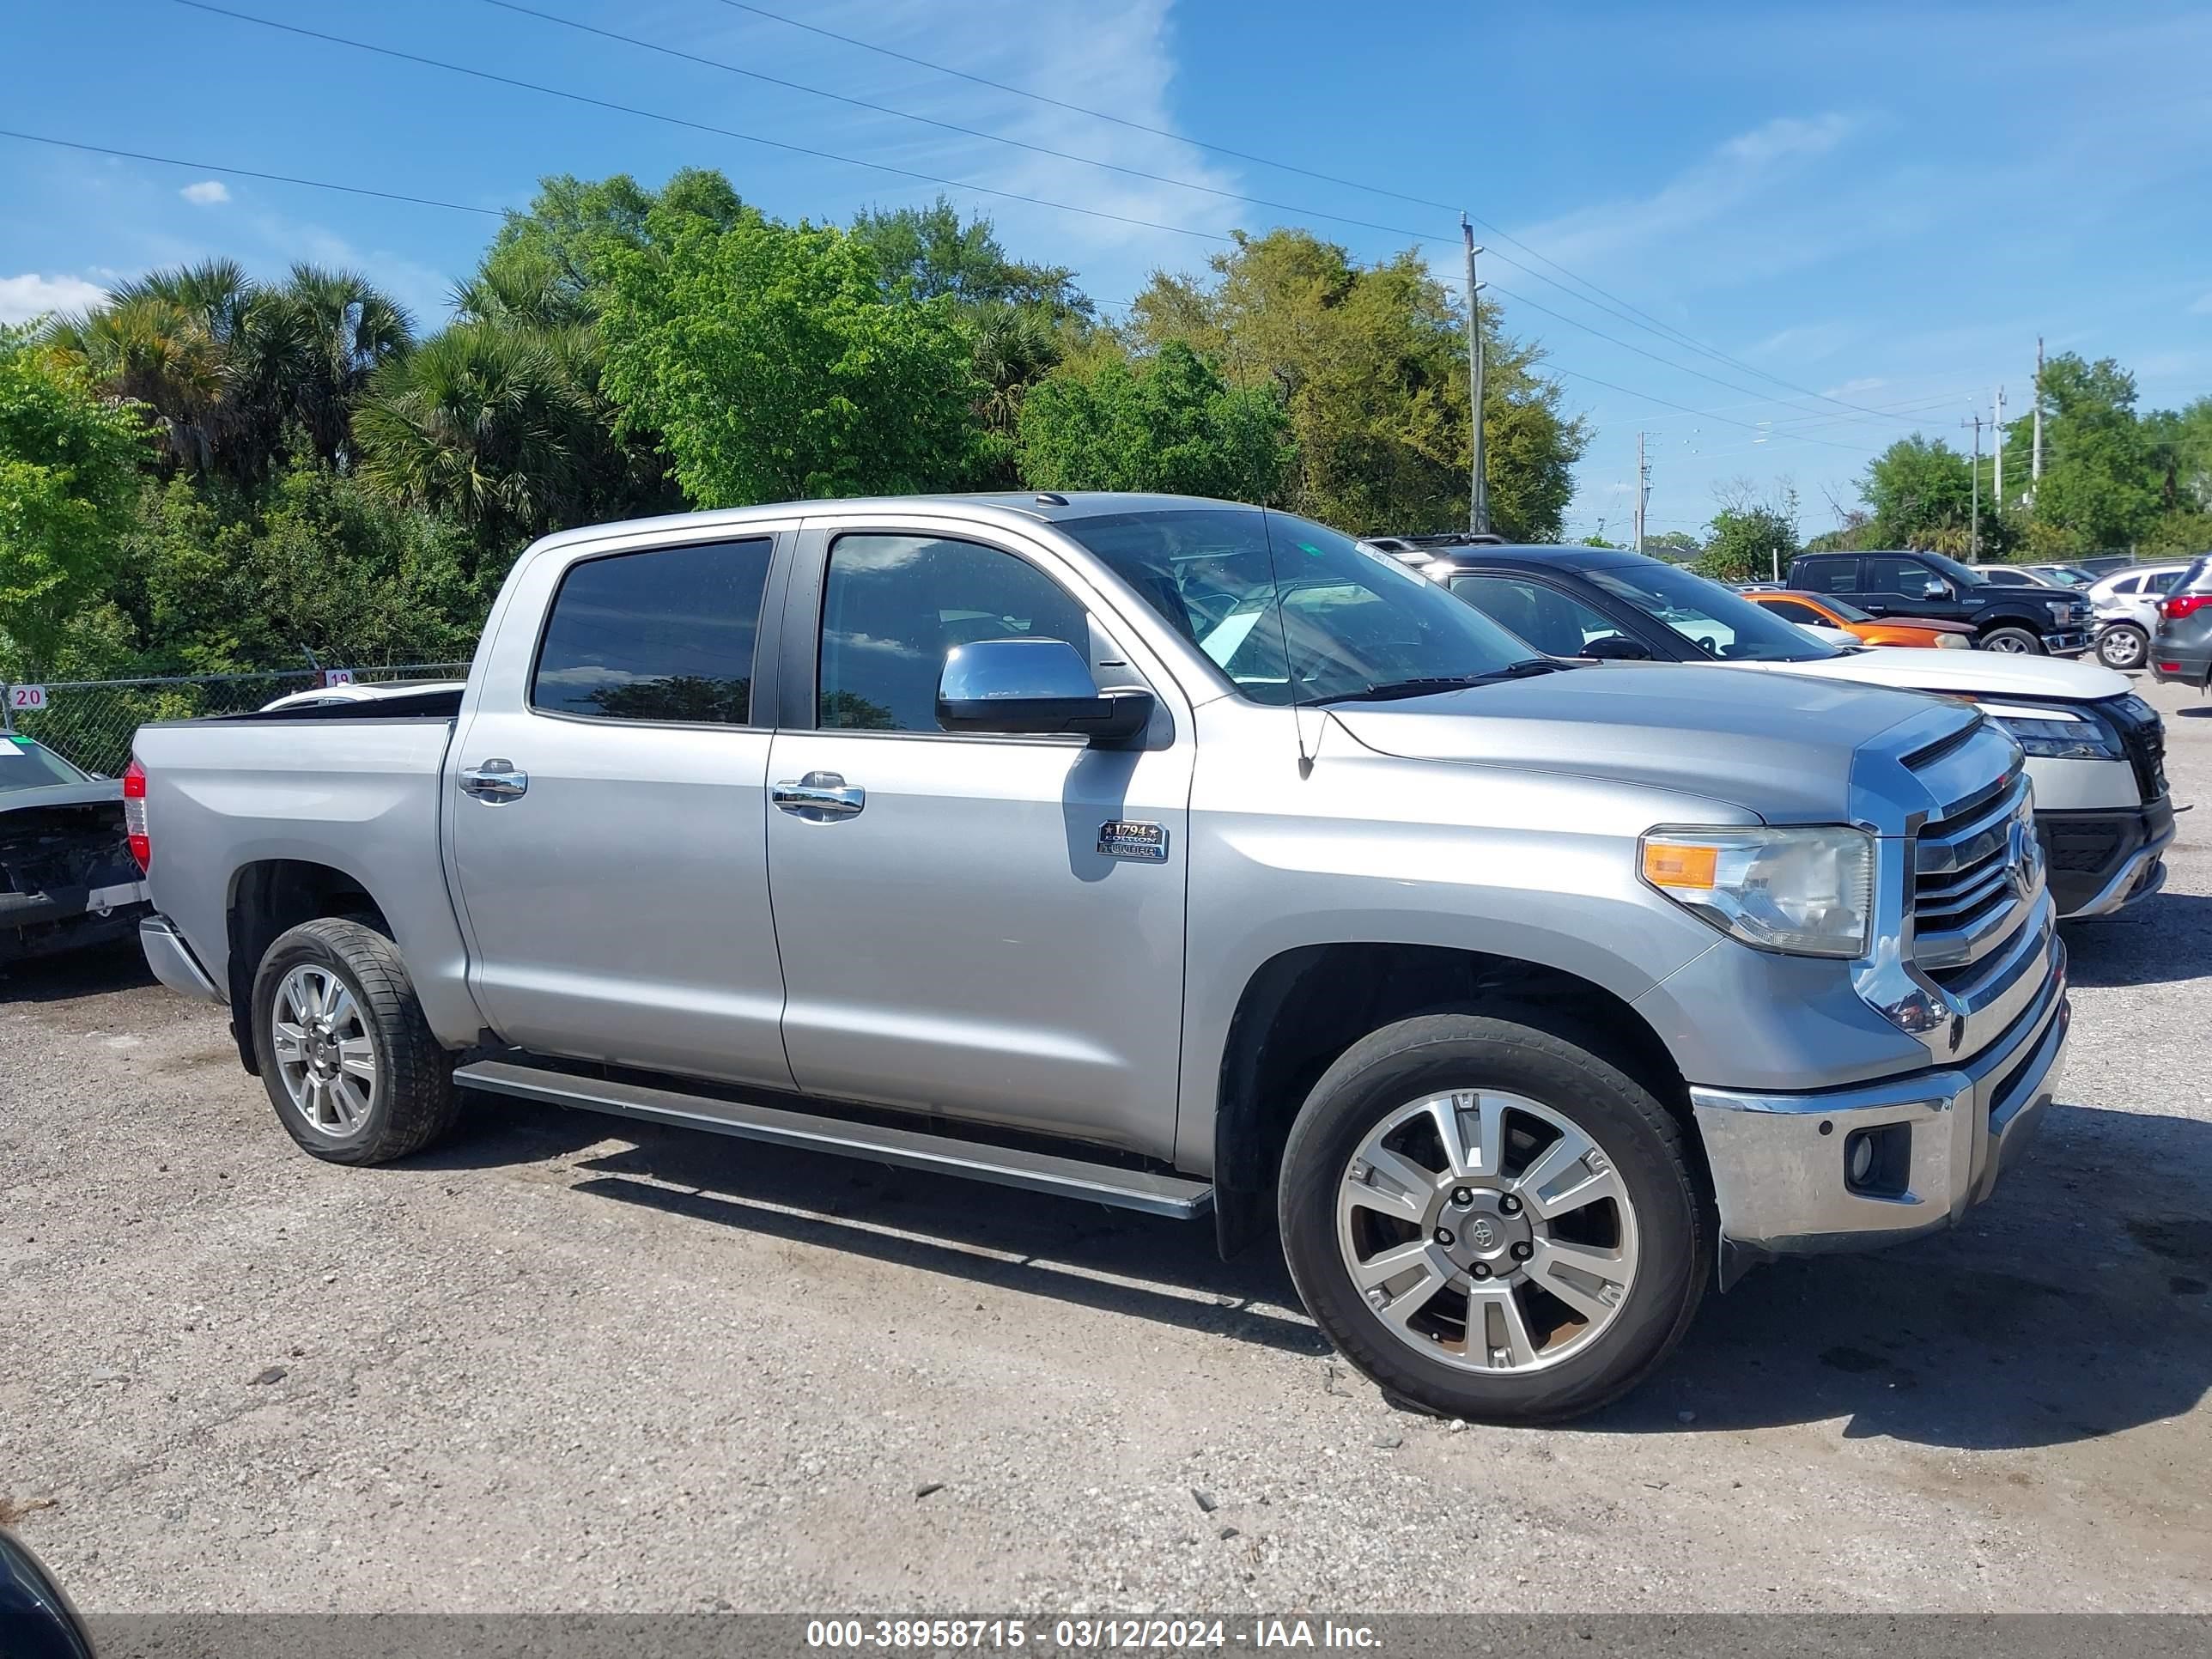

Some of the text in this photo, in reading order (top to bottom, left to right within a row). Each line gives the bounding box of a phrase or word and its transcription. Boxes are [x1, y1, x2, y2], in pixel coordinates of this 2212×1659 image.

[15, 690, 41, 706] 20
[1115, 824, 1147, 836] 1794
[1104, 836, 1157, 844] EDITION
[1103, 843, 1157, 856] TUNDRA
